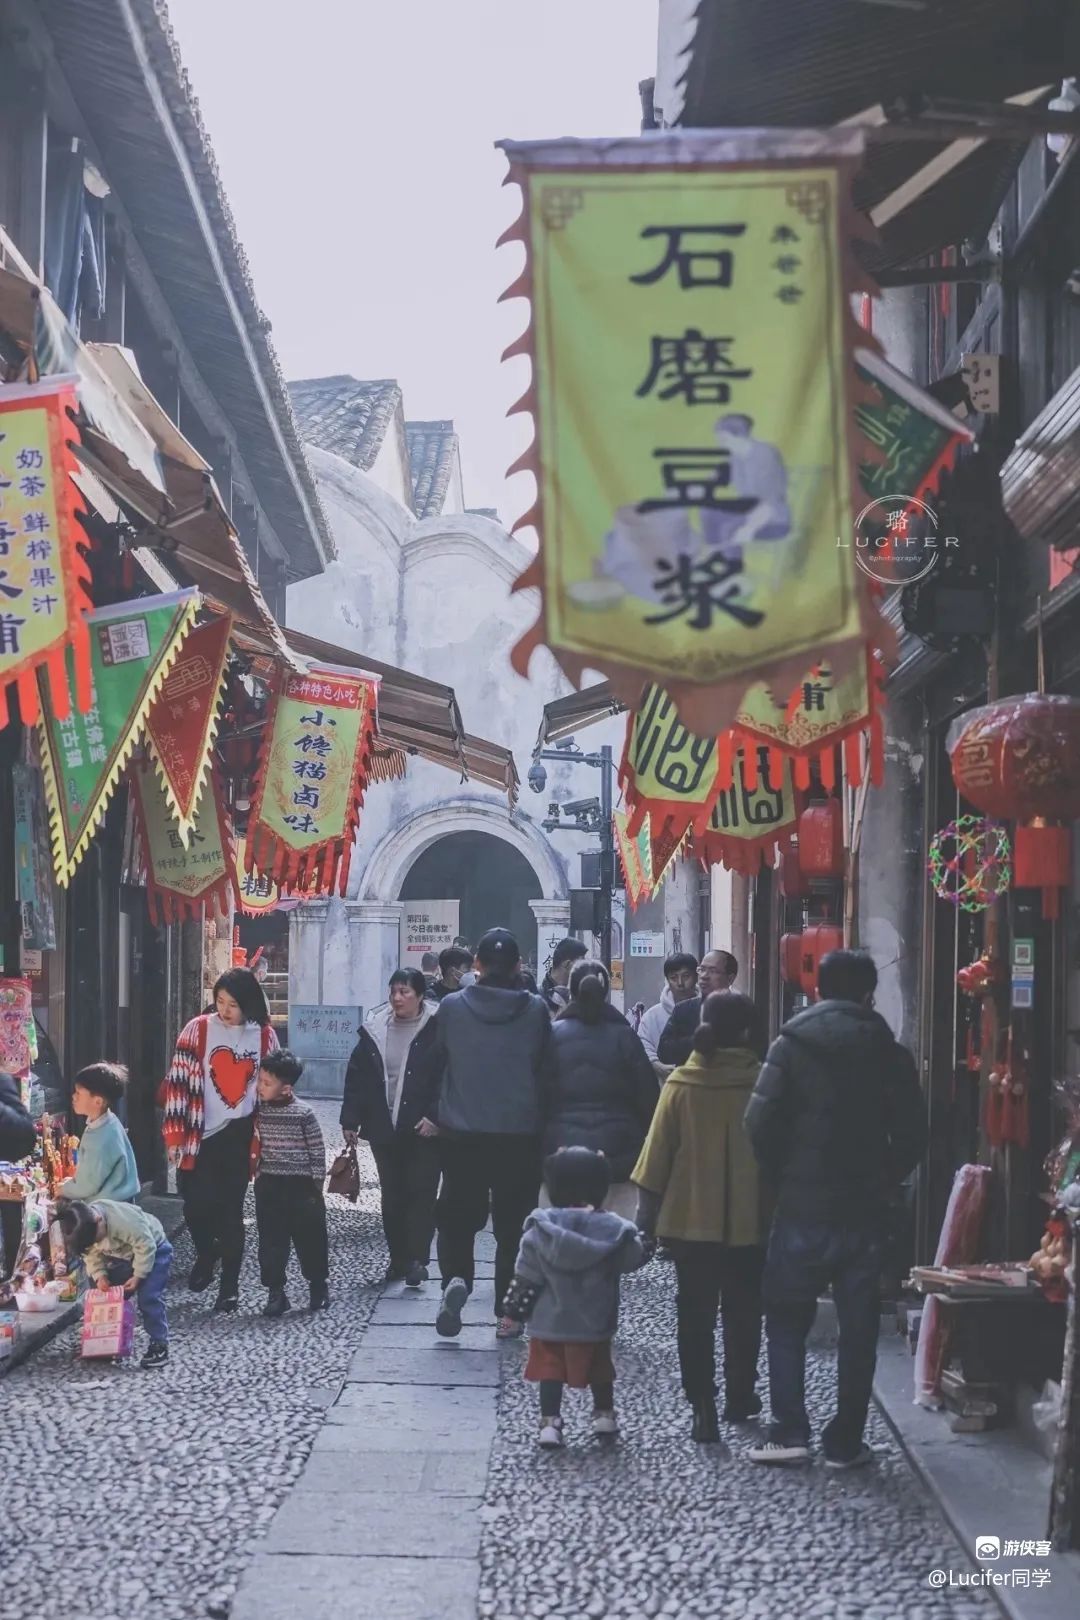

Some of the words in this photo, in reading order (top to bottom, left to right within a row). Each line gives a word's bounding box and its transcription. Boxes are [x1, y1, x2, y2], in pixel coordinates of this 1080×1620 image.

[16, 449, 46, 497] 奶茶
[628, 222, 767, 631] 石磨豆浆
[23, 513, 58, 614] 鲜榨果汁
[286, 680, 357, 704] 各种特色小吃
[282, 710, 337, 834] 小馋猫卤味
